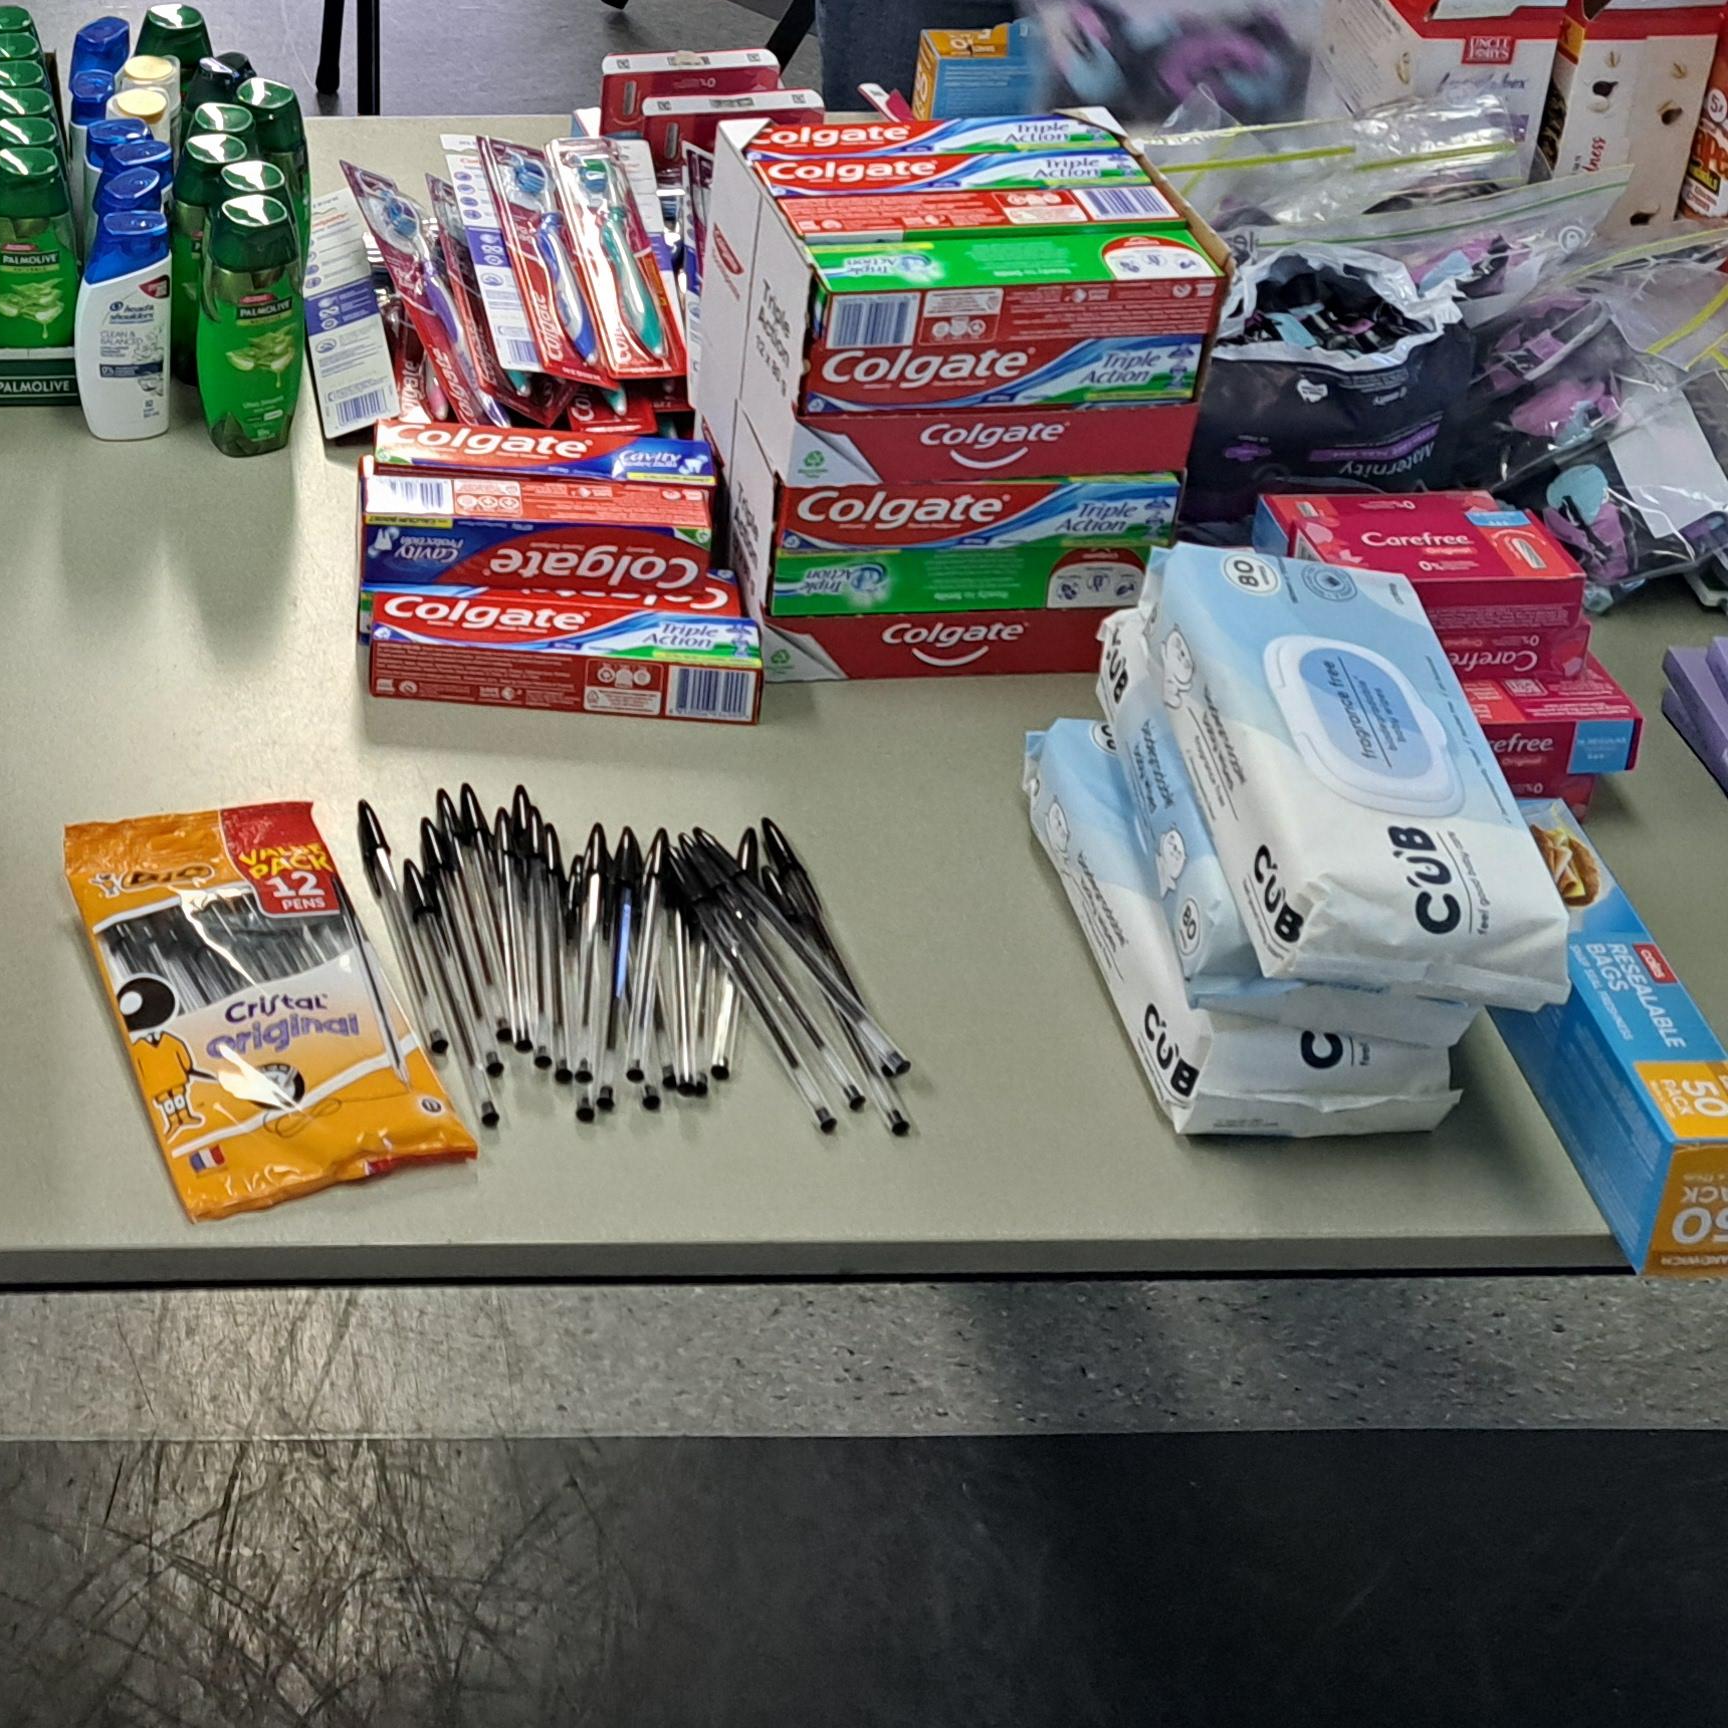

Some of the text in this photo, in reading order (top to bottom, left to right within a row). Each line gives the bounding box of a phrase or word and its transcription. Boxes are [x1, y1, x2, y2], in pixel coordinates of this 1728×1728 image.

[1005, 131, 1071, 144] Action
[1015, 121, 1068, 134] Triple
[767, 159, 936, 186] Colgate
[1034, 165, 1101, 179] Action
[1044, 155, 1100, 170] Triple
[2, 253, 57, 265] PALMOLIVE
[239, 300, 291, 318] PALMOLIVE
[531, 288, 563, 361] Colgate
[822, 346, 1030, 390] Colgate
[1102, 350, 1161, 368] Triple
[1078, 367, 1152, 385] Action
[386, 424, 590, 459] Colgate
[920, 422, 1066, 449] Colgate
[796, 490, 1004, 530] Colgate
[1078, 501, 1138, 519] Triple
[1055, 518, 1128, 534] Action
[1361, 531, 1470, 546] Carefree
[394, 546, 459, 563] Cavity
[489, 546, 700, 589] Colgate
[1232, 560, 1258, 587] 80
[384, 596, 585, 631] Colgate
[642, 631, 716, 648] Action
[658, 622, 720, 639] Triple
[882, 622, 1024, 648] Colgate
[1323, 658, 1379, 760] fragrance free
[238, 842, 324, 867] VALUE
[248, 852, 333, 880] PACK
[270, 870, 327, 898] 12
[1387, 825, 1462, 935] CUB
[281, 895, 327, 912] PENS
[1254, 845, 1304, 944] CUB
[1181, 905, 1197, 941] 80
[1585, 943, 1630, 993] BAGS
[1640, 949, 1665, 980] coles
[224, 993, 325, 1024] Cristal
[1607, 942, 1688, 1049] RESEALABLE
[1143, 1002, 1201, 1098] CUB
[1661, 1078, 1696, 1117] PACK
[1682, 1077, 1728, 1118] 50
